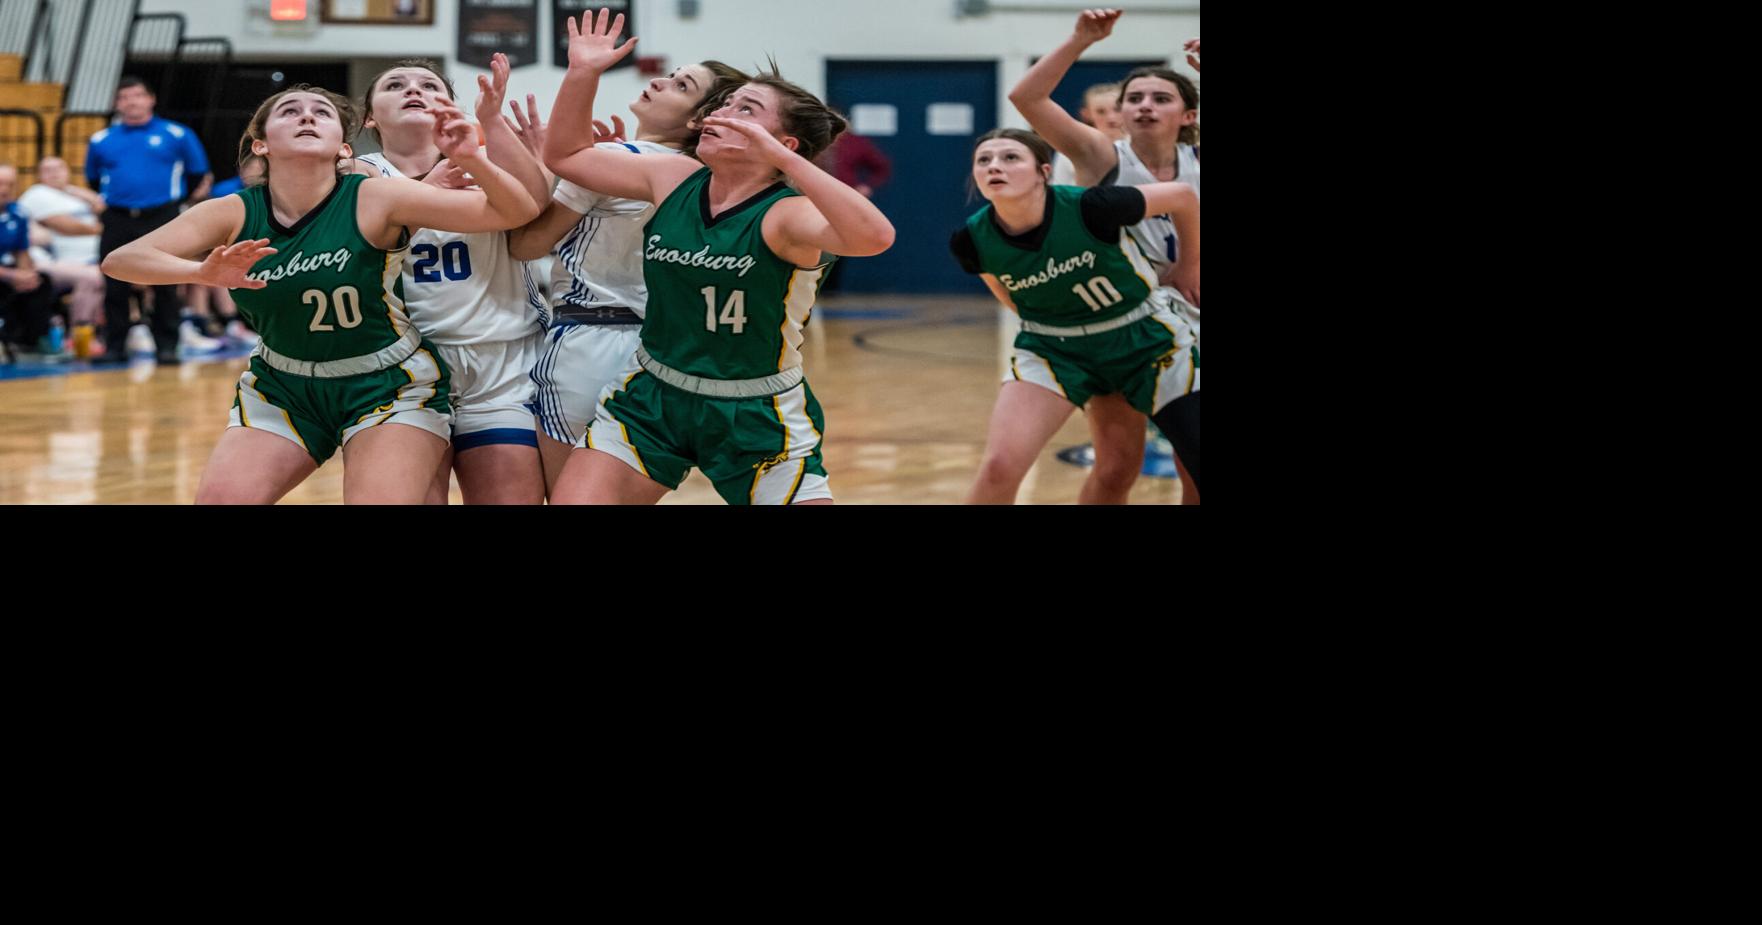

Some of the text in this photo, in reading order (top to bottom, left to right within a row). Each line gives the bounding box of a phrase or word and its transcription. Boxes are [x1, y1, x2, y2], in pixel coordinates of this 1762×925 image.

[232, 247, 352, 289] nosburg
[411, 240, 473, 283] 20
[645, 234, 756, 278] Enosburg
[1000, 250, 1096, 292] Enosburg
[302, 286, 363, 332] 20
[701, 285, 747, 334] 14
[1072, 276, 1123, 312] 10
